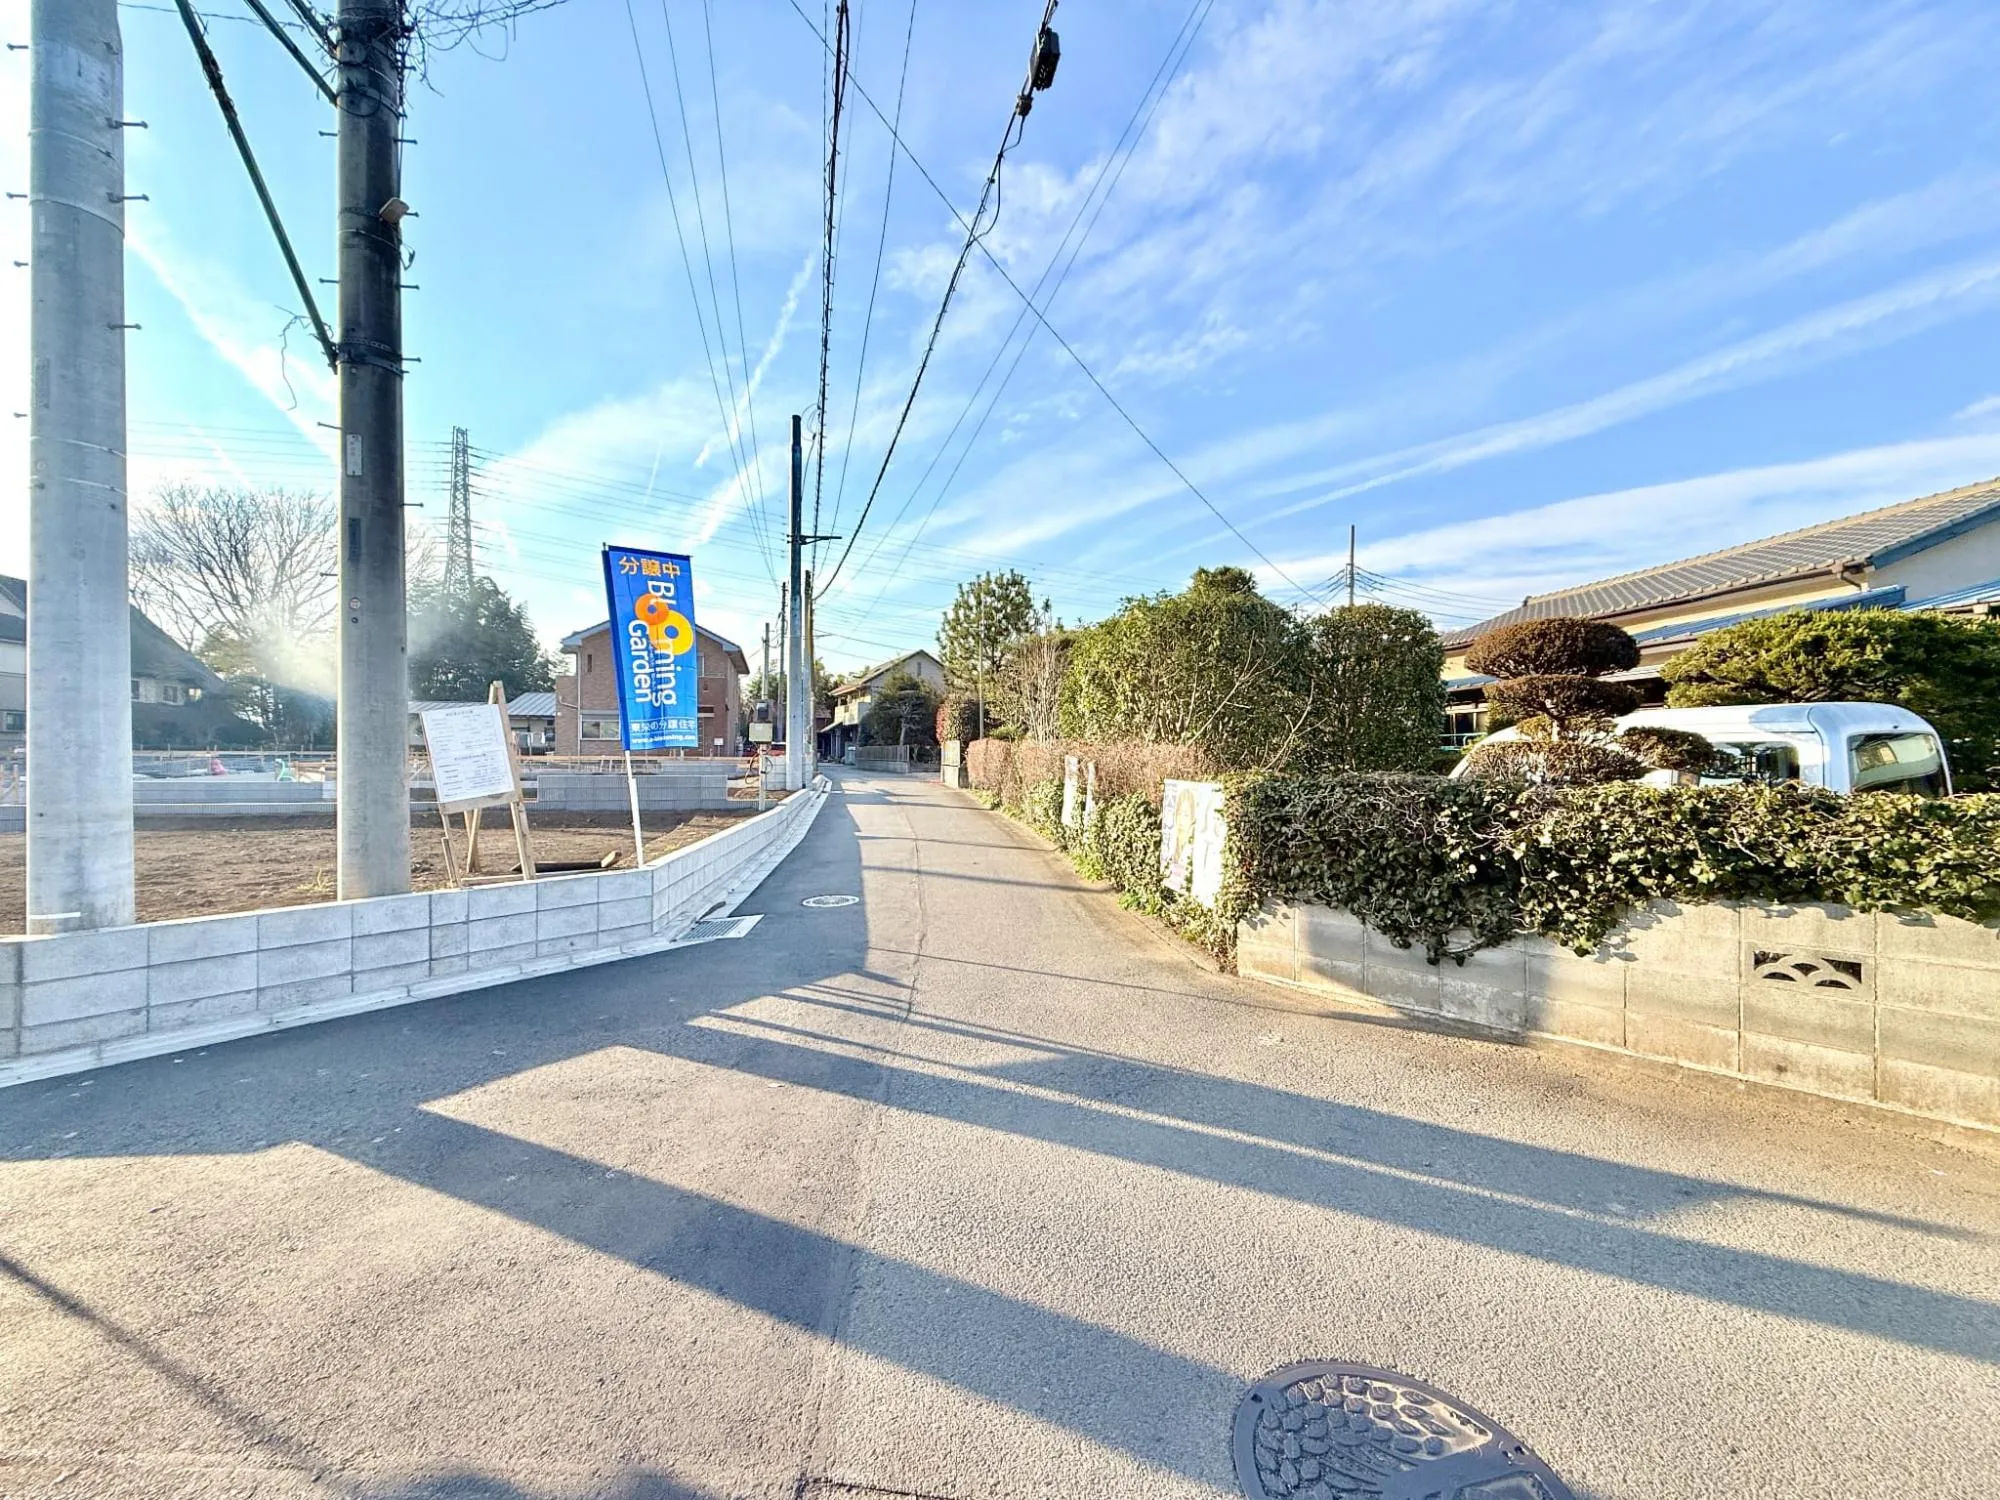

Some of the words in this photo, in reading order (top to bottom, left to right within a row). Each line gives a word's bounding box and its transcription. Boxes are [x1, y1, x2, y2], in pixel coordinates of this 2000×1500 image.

[618, 556, 681, 578] 分譲中
[628, 620, 654, 702] Garden
